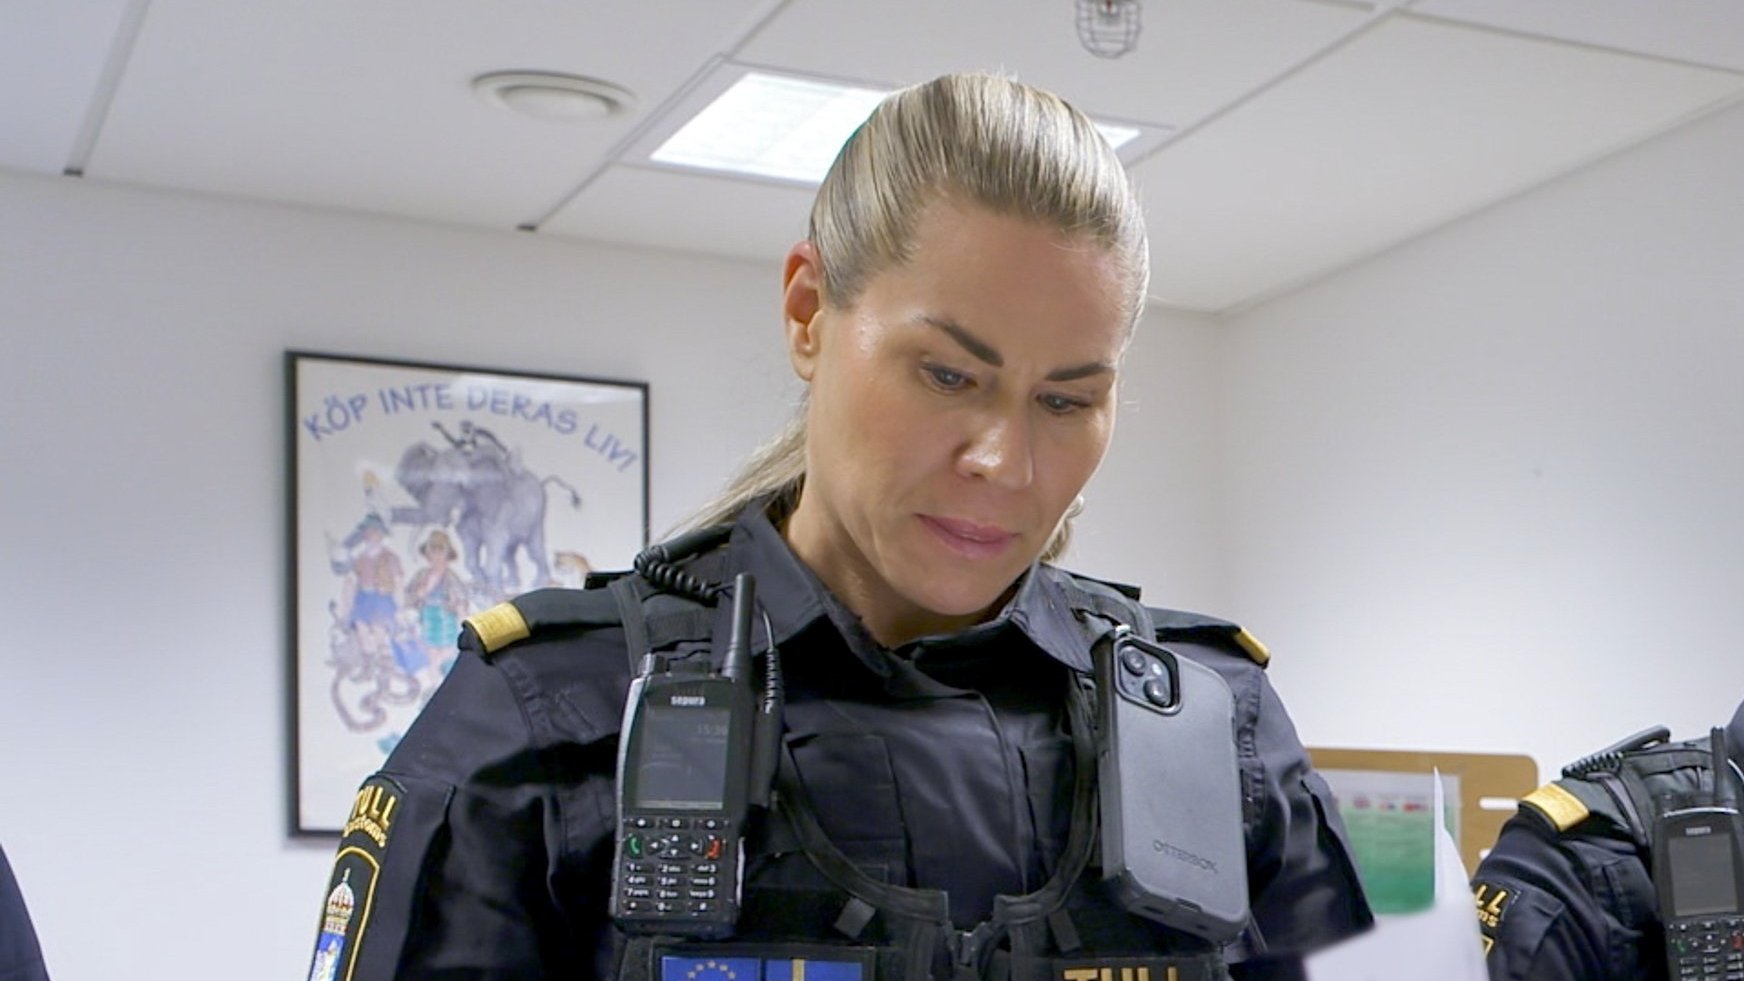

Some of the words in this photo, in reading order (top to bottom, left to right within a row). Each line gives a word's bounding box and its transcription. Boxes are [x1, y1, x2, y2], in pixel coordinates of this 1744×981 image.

[303, 394, 368, 441] KÖP
[379, 384, 454, 415] INTE
[466, 386, 578, 435] DERAS
